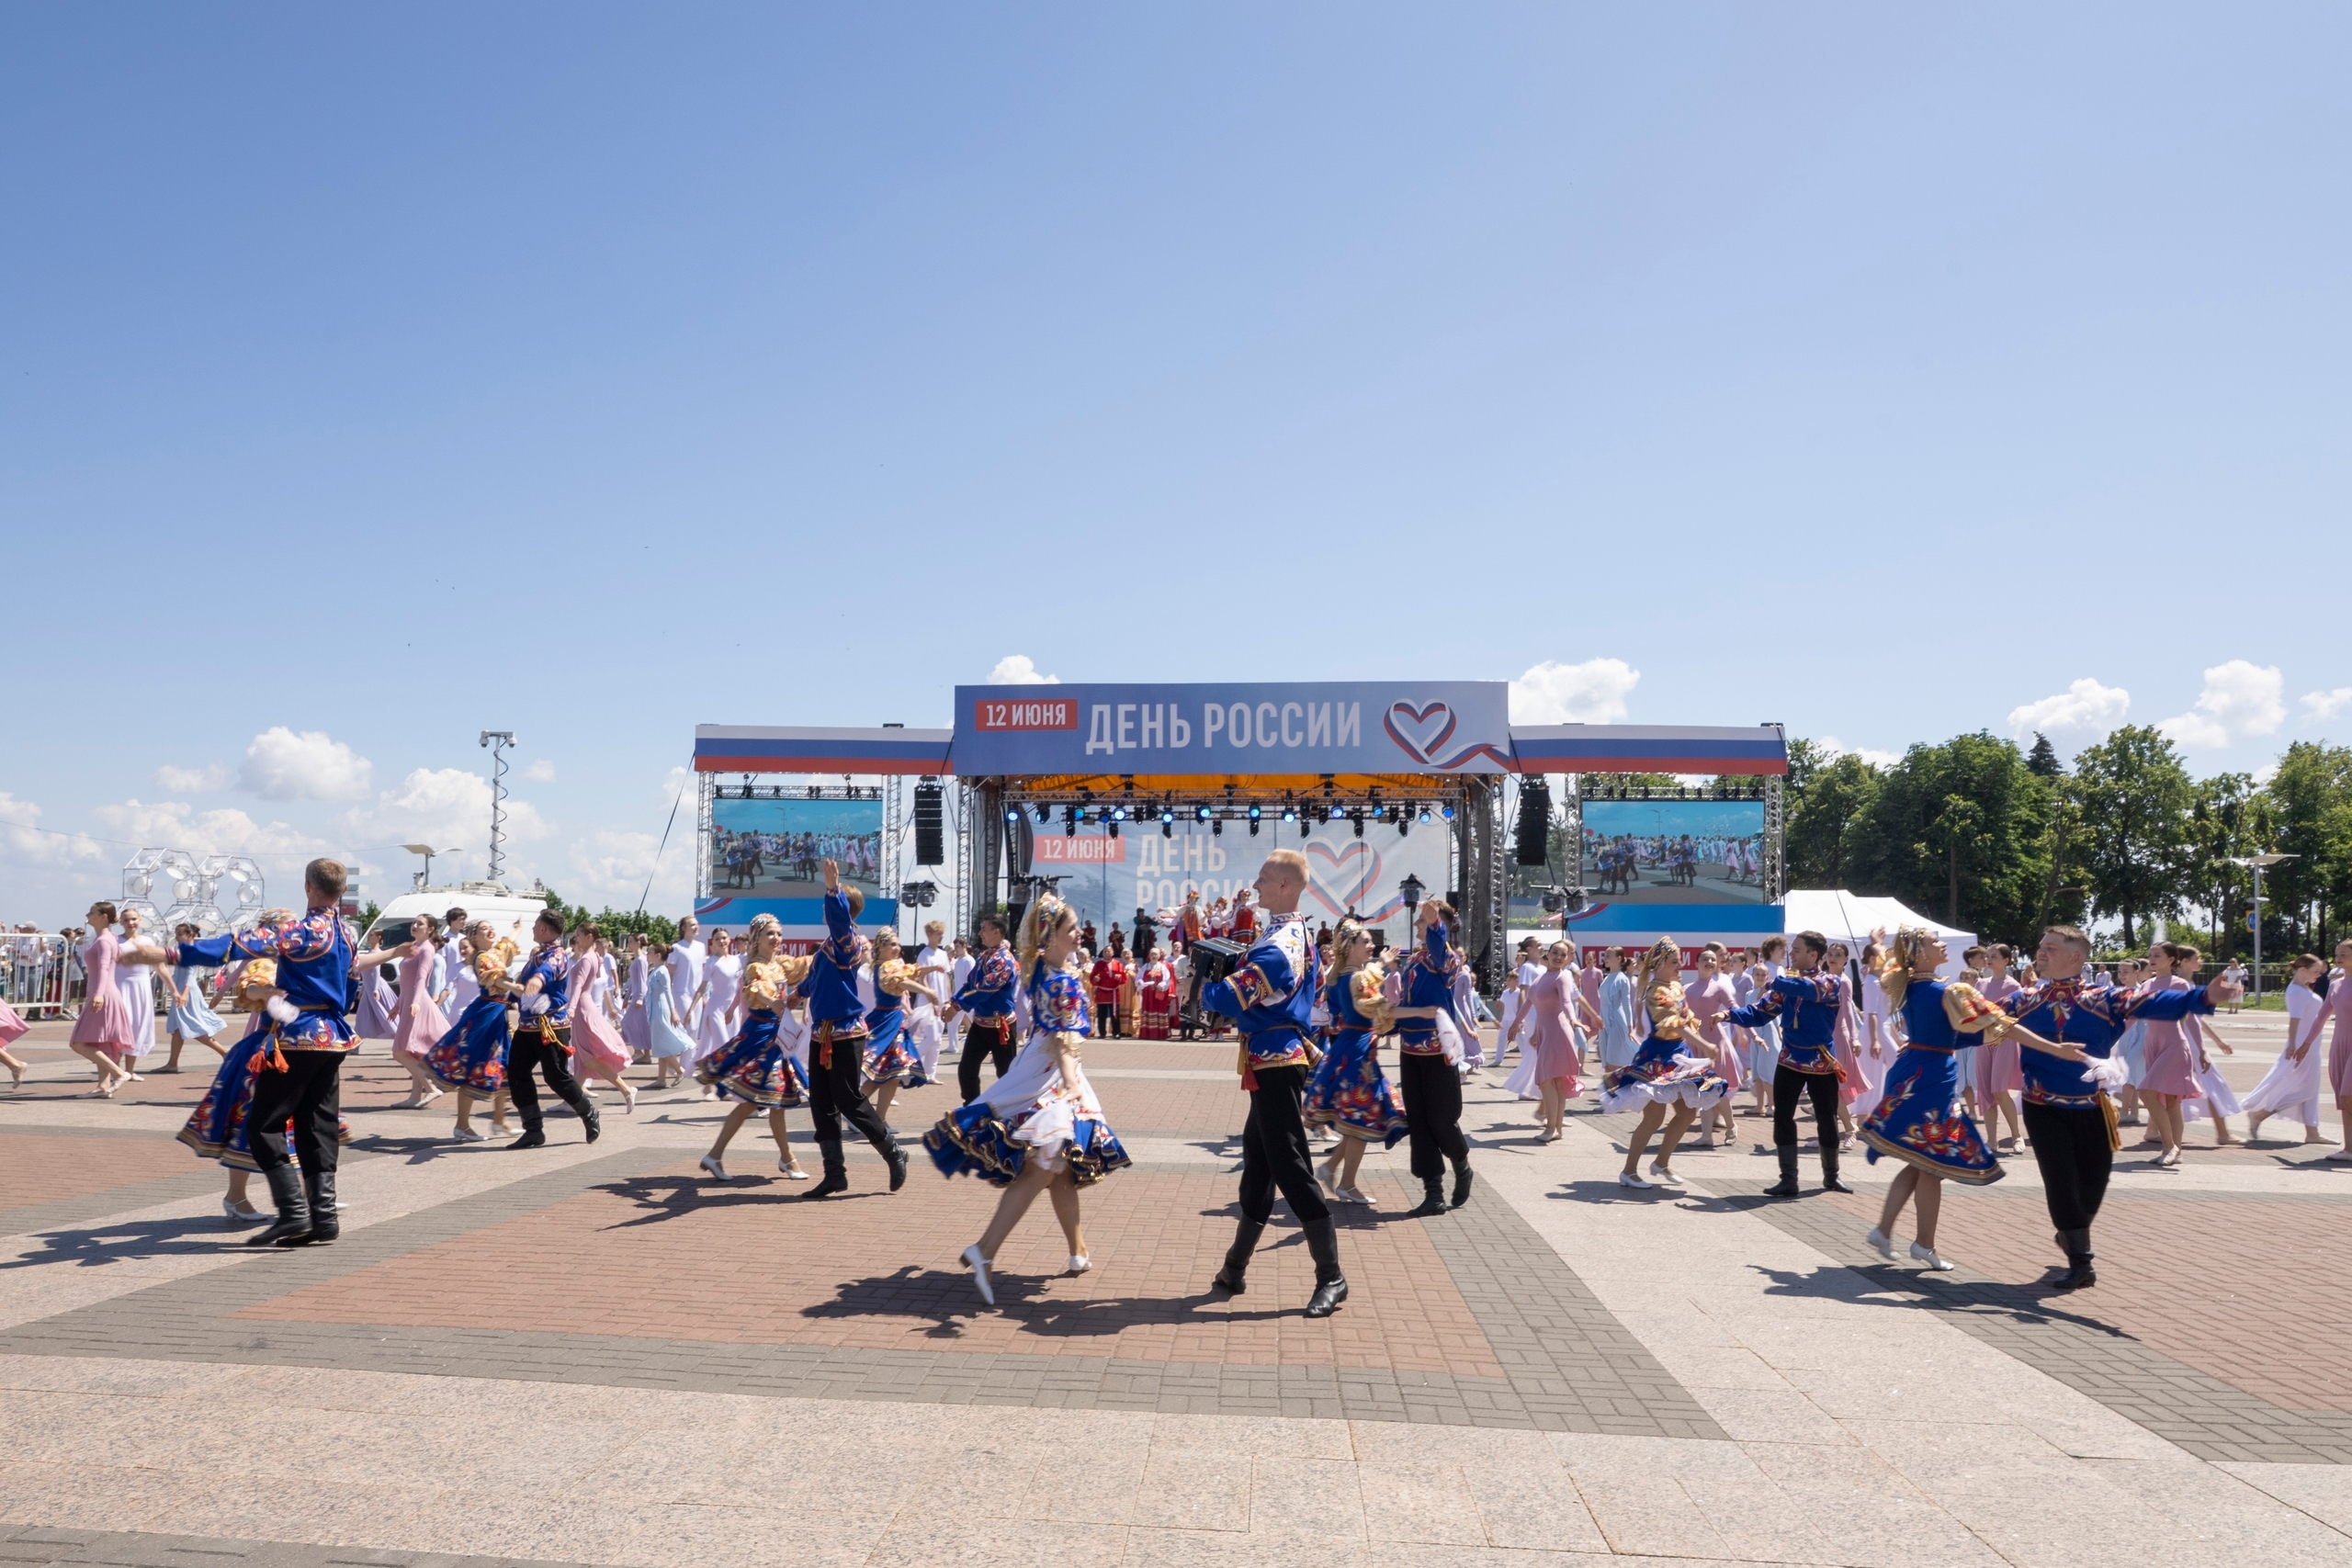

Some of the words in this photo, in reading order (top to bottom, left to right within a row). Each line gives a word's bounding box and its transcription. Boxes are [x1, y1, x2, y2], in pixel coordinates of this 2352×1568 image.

[986, 705, 1007, 727] 12
[1012, 704, 1067, 726] ИЮНЯ
[1086, 704, 1191, 755] ДЕНЬ
[1204, 702, 1361, 748] РОССИИ
[1044, 839, 1062, 859] 12
[1067, 839, 1115, 859] ИЮНЯ
[1136, 834, 1227, 877] ДЕНЬ
